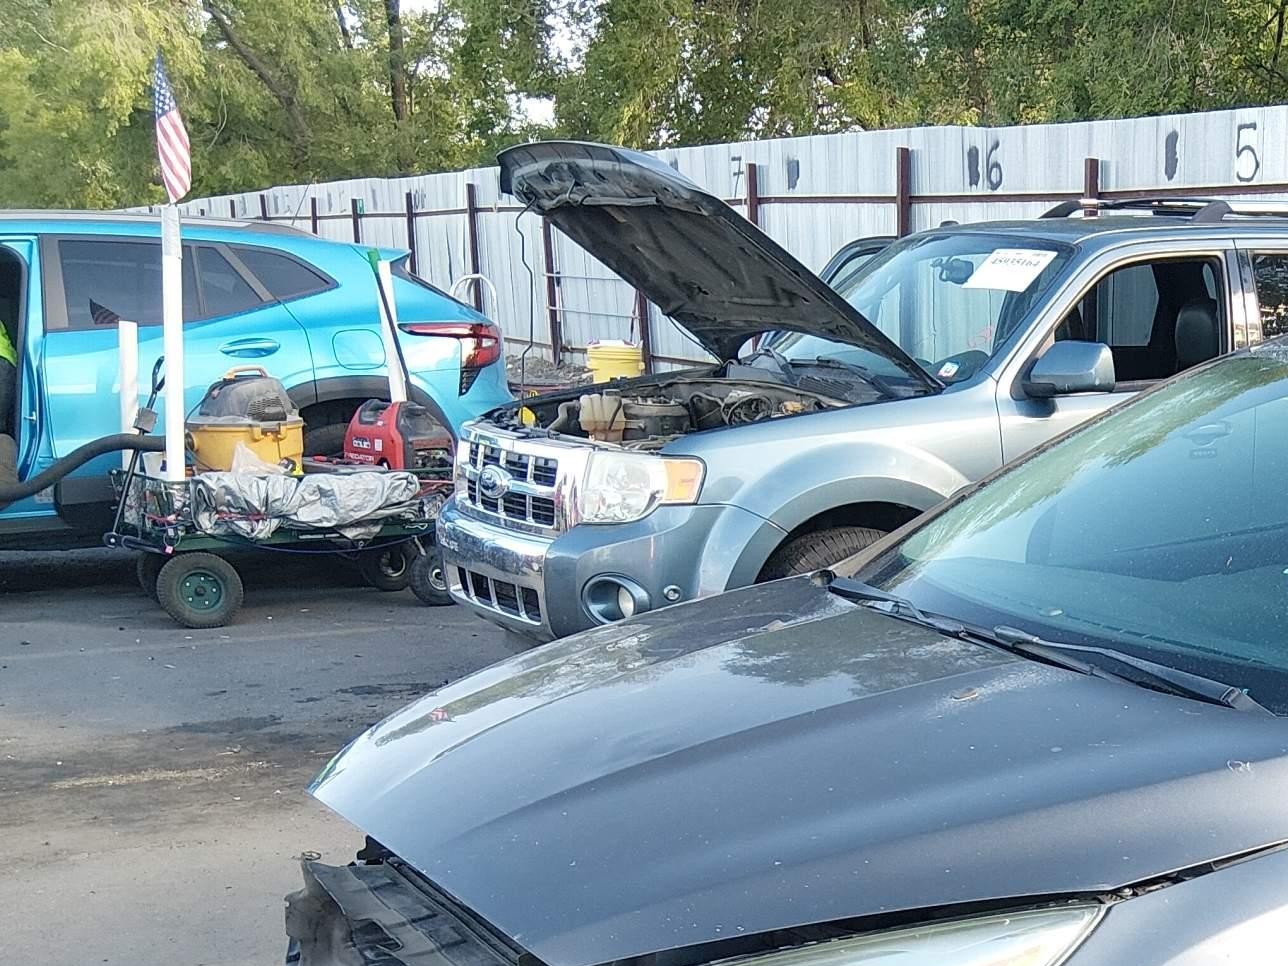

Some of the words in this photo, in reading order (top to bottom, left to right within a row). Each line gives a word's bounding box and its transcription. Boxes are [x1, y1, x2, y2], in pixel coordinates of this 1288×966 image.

[731, 156, 744, 198] 7
[987, 140, 1002, 191] 6
[1236, 122, 1259, 182] 5
